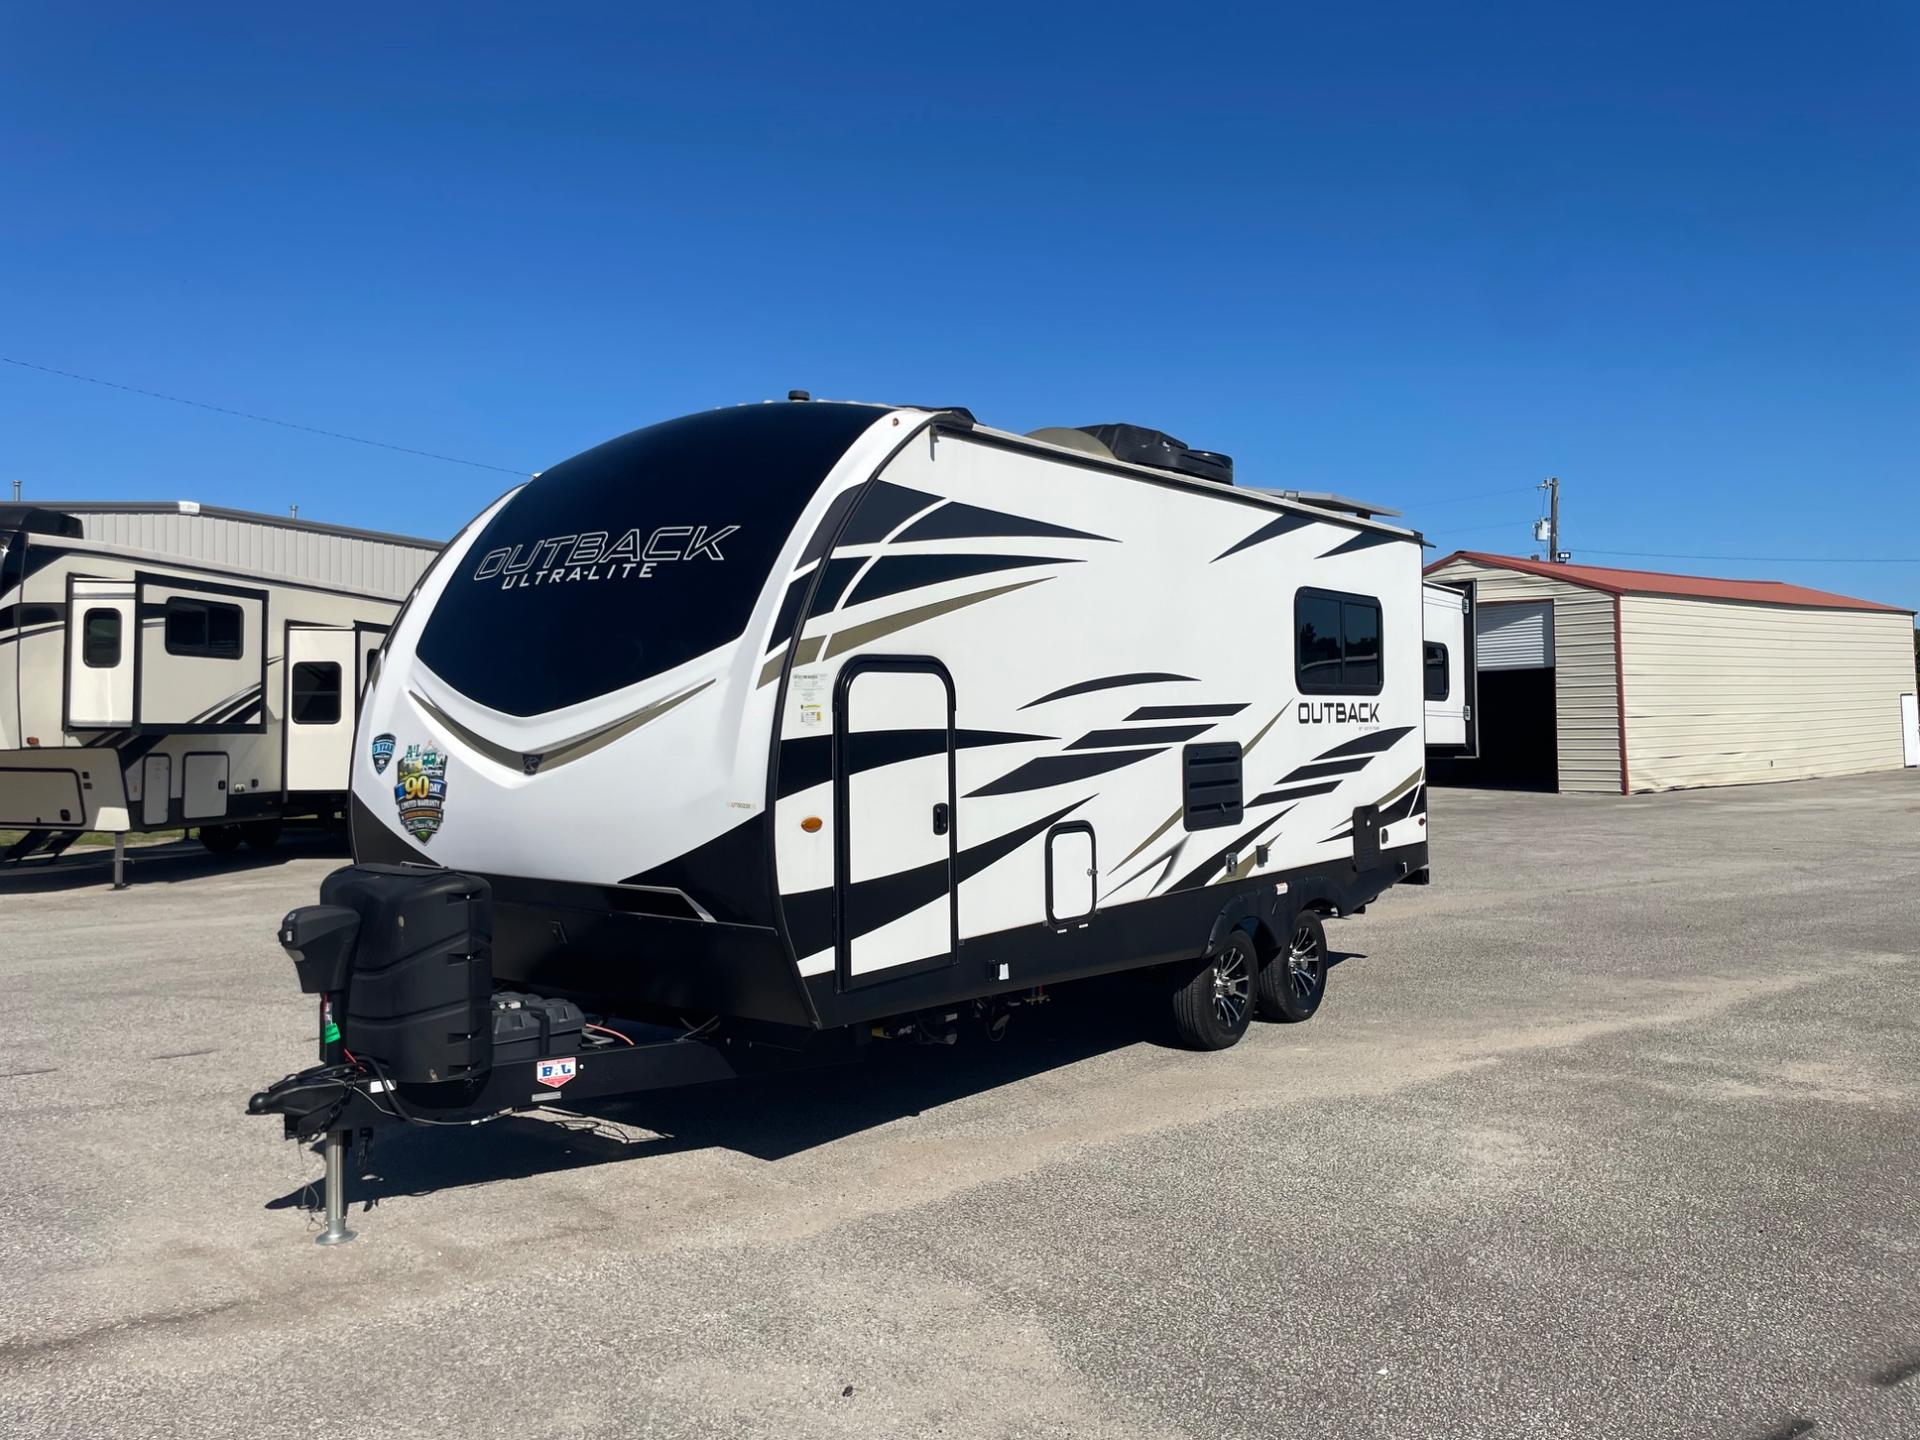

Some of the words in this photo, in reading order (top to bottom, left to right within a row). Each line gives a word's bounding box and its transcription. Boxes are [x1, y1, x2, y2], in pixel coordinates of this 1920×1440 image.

[474, 525, 741, 581] OUTBACK
[502, 562, 658, 590] ULTRA-LITE
[1298, 702, 1380, 724] OUTBACK
[405, 776, 429, 799] 90
[429, 783, 441, 793] DAY
